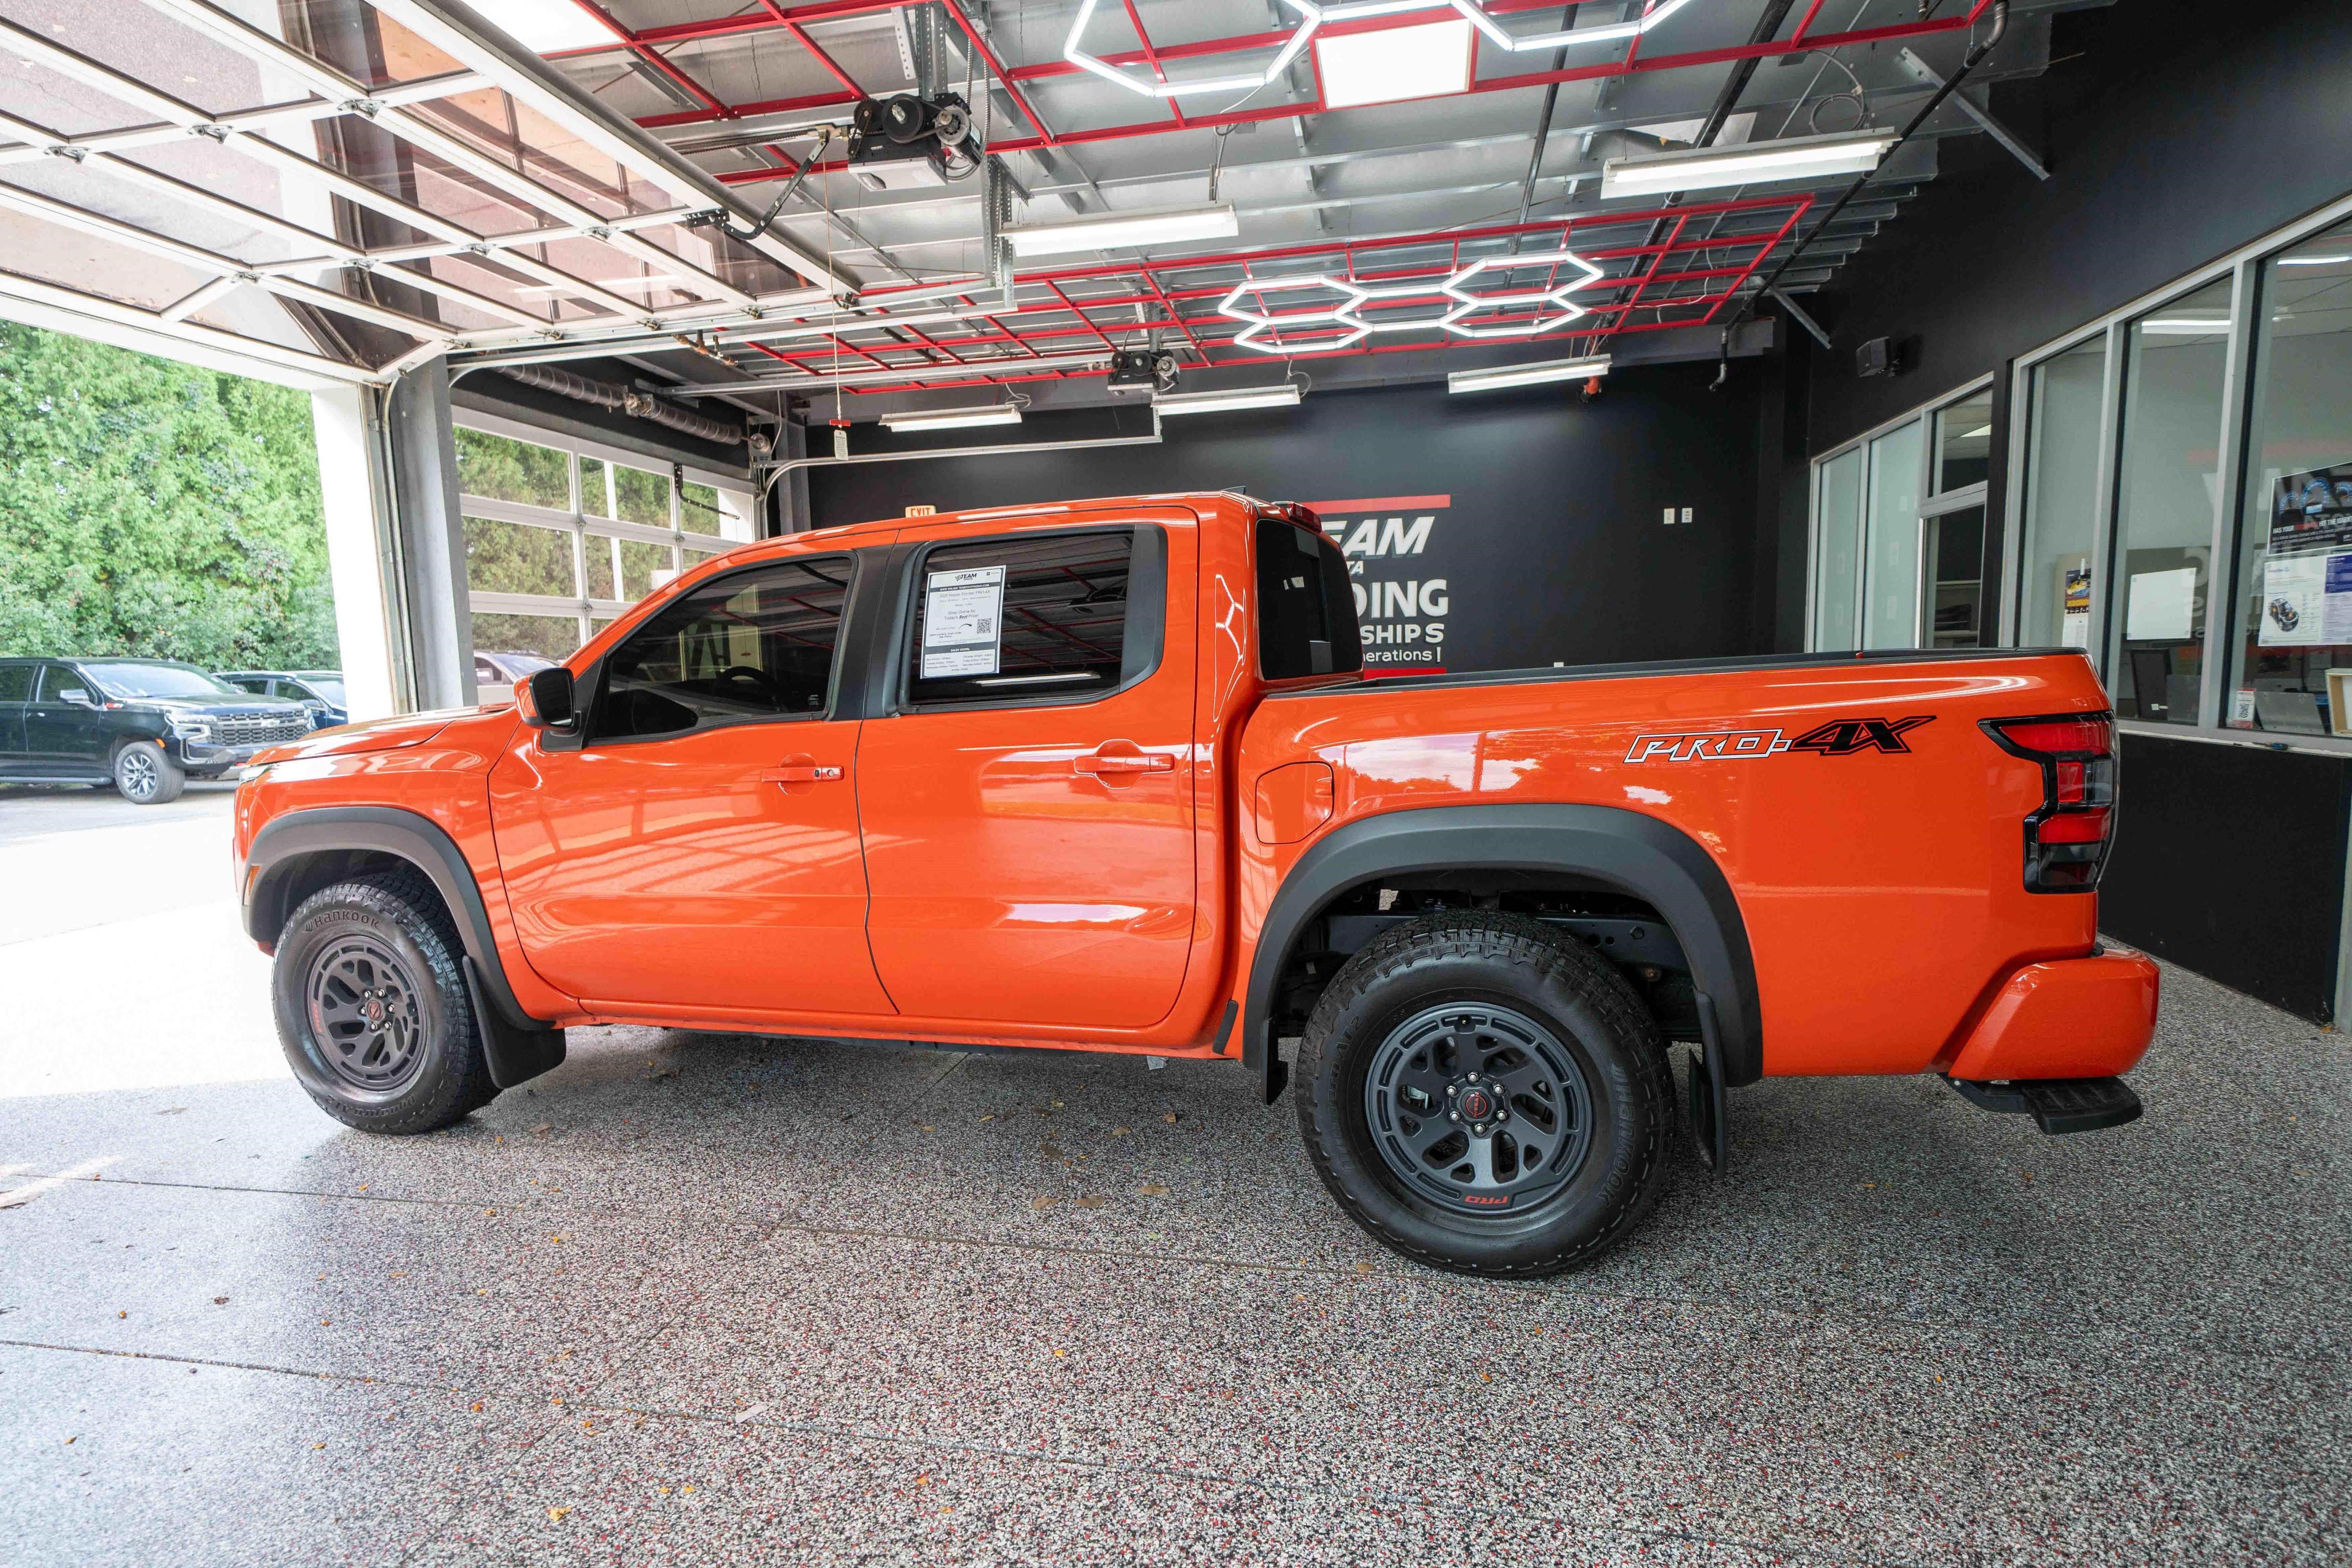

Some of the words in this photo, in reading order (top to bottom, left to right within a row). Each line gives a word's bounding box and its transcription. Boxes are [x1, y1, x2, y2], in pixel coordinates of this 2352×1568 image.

[910, 508, 931, 517] EXIT
[1360, 623, 1445, 645] SHIPS
[1463, 1195, 1509, 1205] PRO
